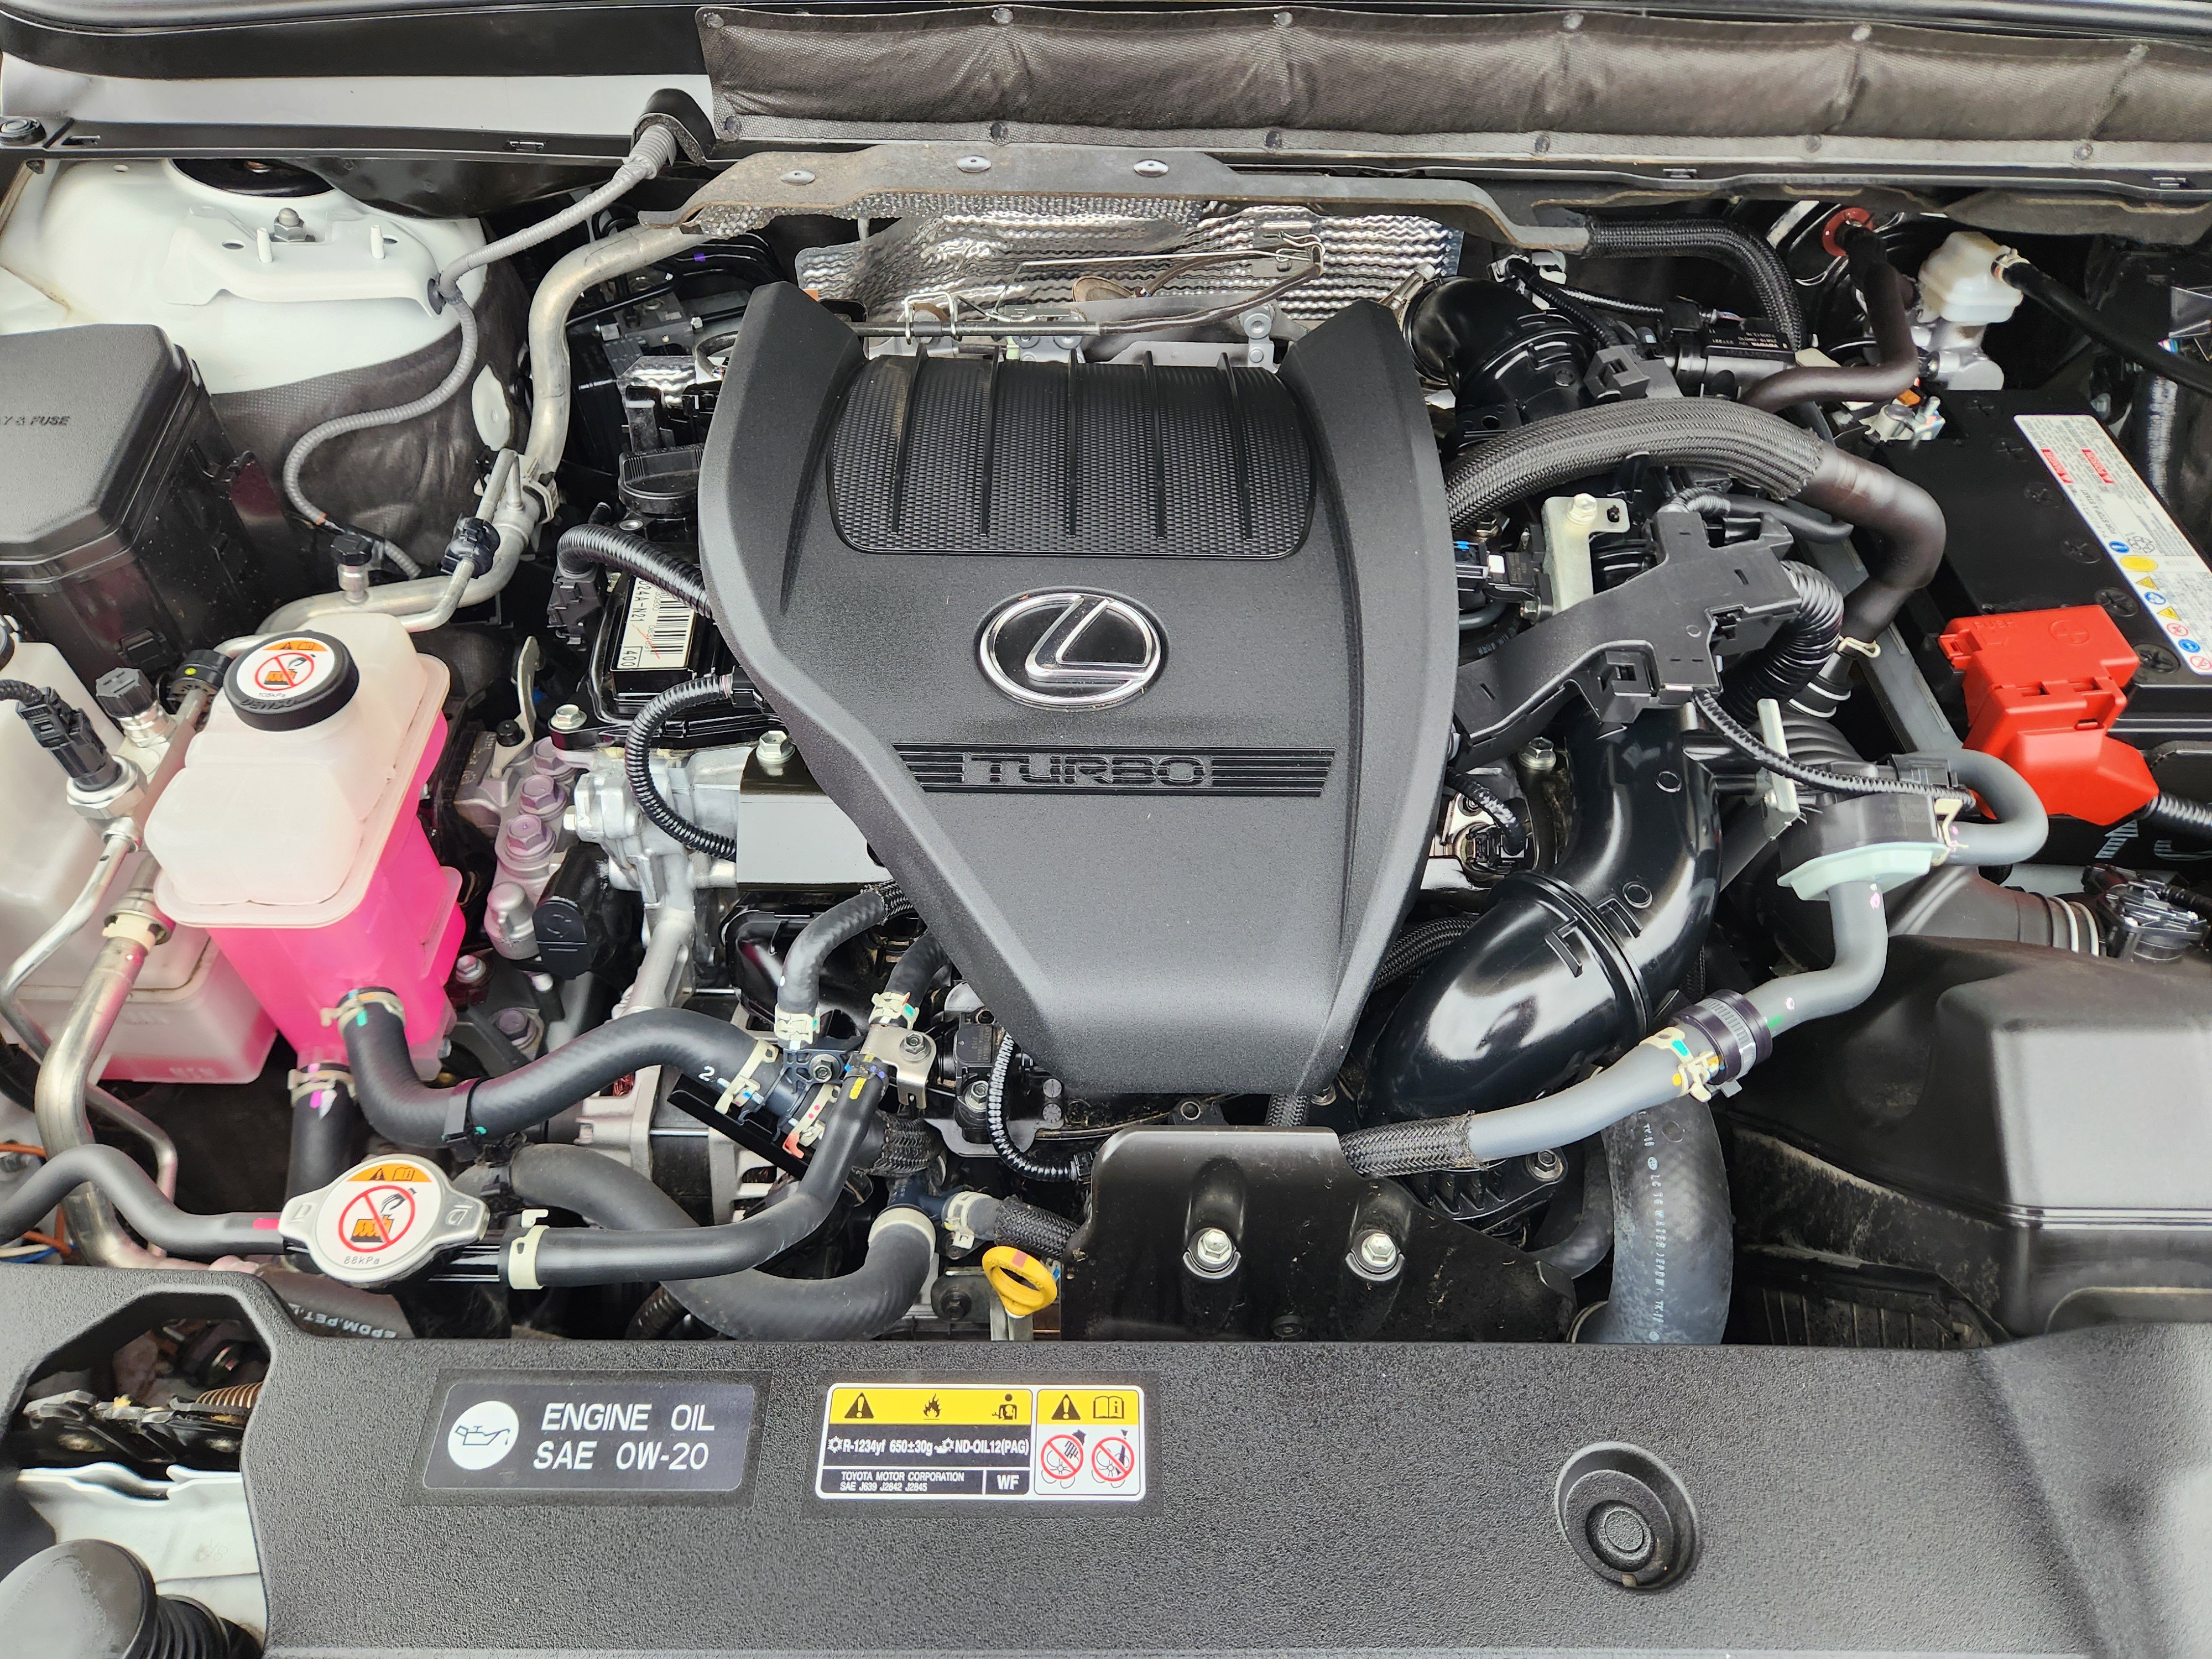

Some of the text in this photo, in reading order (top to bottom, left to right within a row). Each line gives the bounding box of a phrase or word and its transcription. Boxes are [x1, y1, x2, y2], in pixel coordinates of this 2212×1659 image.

[30, 415, 70, 425] FUSE
[621, 650, 638, 666] 400
[968, 754, 1206, 786] TURBO
[698, 1066, 716, 1083] 2
[1655, 1210, 1666, 1249] WATER
[343, 1255, 380, 1265] 88kPa
[541, 1402, 716, 1431] ENGINE OIL
[533, 1440, 709, 1470] SAE 0W-20
[843, 1438, 1029, 1457] R-1234yf 650±30g ND-OIL12(PAG)
[841, 1471, 965, 1482] TOYOTA MOTOR CORPORATION
[997, 1474, 1019, 1490] WF
[839, 1481, 928, 1492] SAE J639 J2842 J2845
